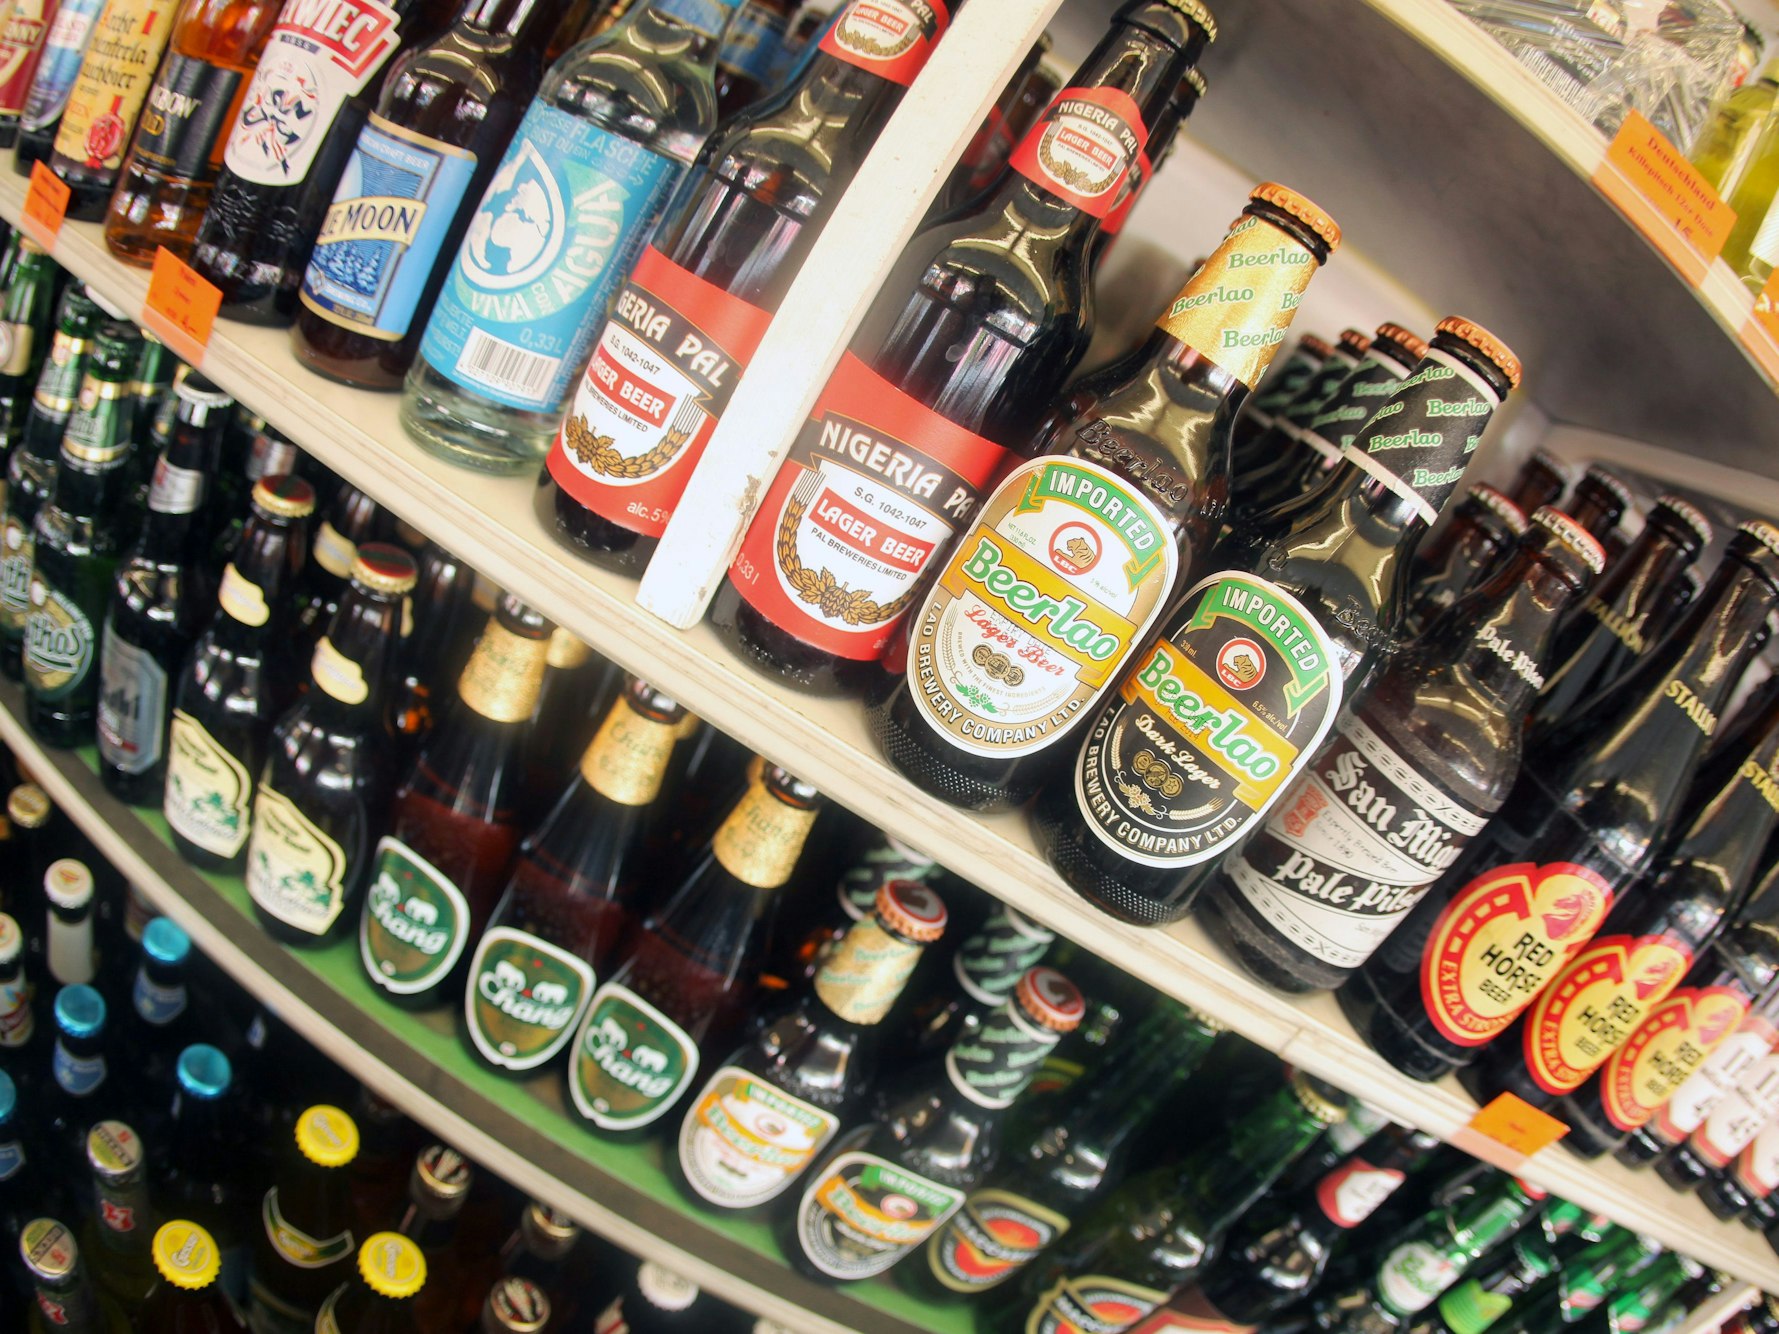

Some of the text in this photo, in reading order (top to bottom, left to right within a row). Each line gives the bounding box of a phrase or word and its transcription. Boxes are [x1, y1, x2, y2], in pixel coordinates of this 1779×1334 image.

[911, 0, 933, 23] PAL
[1057, 101, 1139, 155] NIGERIA PAL
[1060, 129, 1114, 167] LAGER BEER
[1647, 136, 1716, 211] Deutschland
[344, 202, 418, 234] MOON
[470, 290, 533, 321] VIVA
[551, 176, 623, 306] AGUA
[1228, 247, 1313, 270] Beerlao
[1170, 285, 1255, 318] Beerlao
[621, 344, 661, 376] 1042-1047
[675, 331, 731, 389] PAL
[617, 409, 649, 433] LIMITED
[620, 380, 666, 420] BEER
[1426, 398, 1492, 418] Beerlao
[818, 418, 943, 499] NIGERIA
[1078, 418, 1189, 504] Beerlao
[1368, 429, 1443, 454] Beerlao
[626, 499, 650, 520] alc.
[816, 498, 926, 568] LAGER BEER
[853, 486, 928, 530] S.G. 1042-1047
[1048, 468, 1156, 551] IMPORTED
[811, 527, 907, 582] PAL BREWERIES LIMITED
[1052, 555, 1078, 576] LBC
[961, 536, 1120, 661] Beerlao
[964, 604, 1065, 676] Lager Beer
[1221, 585, 1320, 673] IMPORTED
[1474, 626, 1515, 663] Pale
[918, 600, 1086, 745] LAO BREWERY COMPANY LTD.
[1221, 670, 1242, 688] LBC
[1138, 649, 1279, 780] Beerlao
[1082, 705, 1244, 854] LAO BREWERY COMPANY LTD.
[1134, 714, 1223, 790] Dark Lager
[1325, 750, 1398, 832] San
[1273, 851, 1356, 902] Pale
[368, 882, 449, 955] Chang
[1479, 943, 1544, 994] HORSE
[1513, 931, 1556, 967] RED
[478, 971, 574, 1030] Chang
[1439, 959, 1463, 1019] EXTRA
[584, 1025, 674, 1098] Chang
